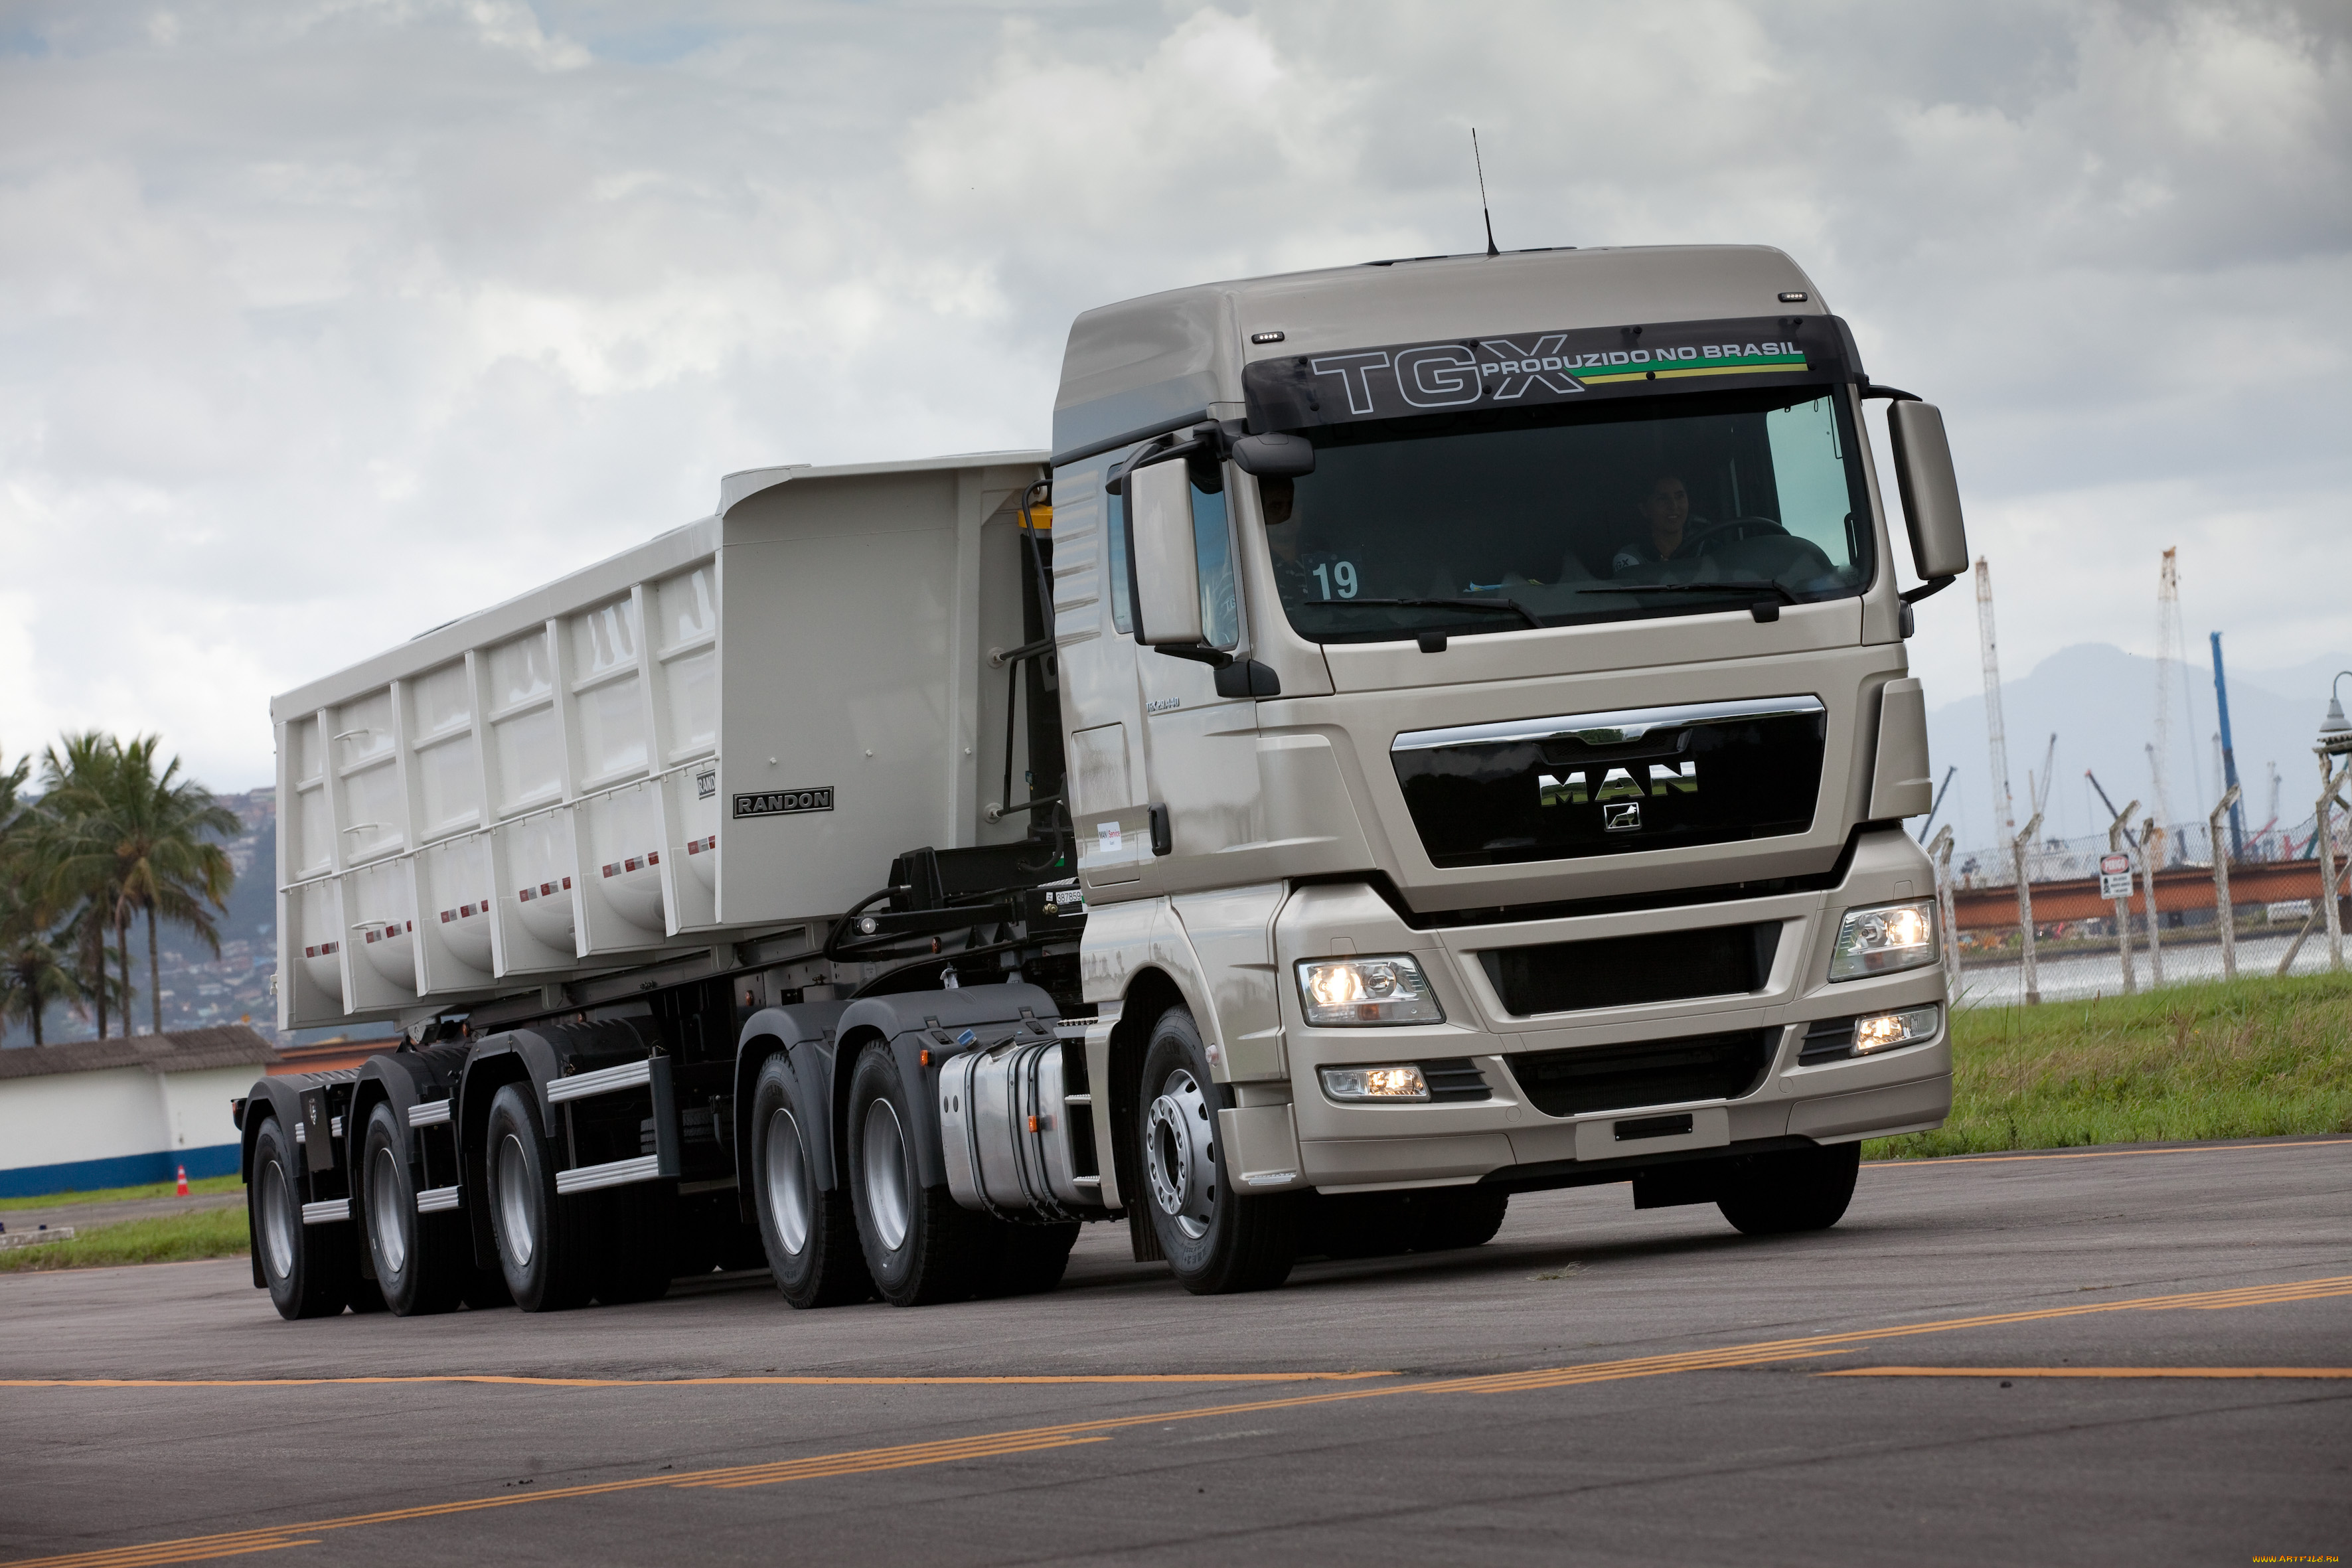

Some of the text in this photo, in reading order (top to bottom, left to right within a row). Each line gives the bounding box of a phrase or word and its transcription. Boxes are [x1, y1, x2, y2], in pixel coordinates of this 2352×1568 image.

[1311, 334, 1585, 414] TGX
[1483, 341, 1804, 377] PRODUZIDO NO BRASIL
[1312, 561, 1358, 600] 19
[738, 791, 828, 813] RANDON
[1538, 761, 1699, 807] MAN
[1057, 892, 1081, 903] 387859
